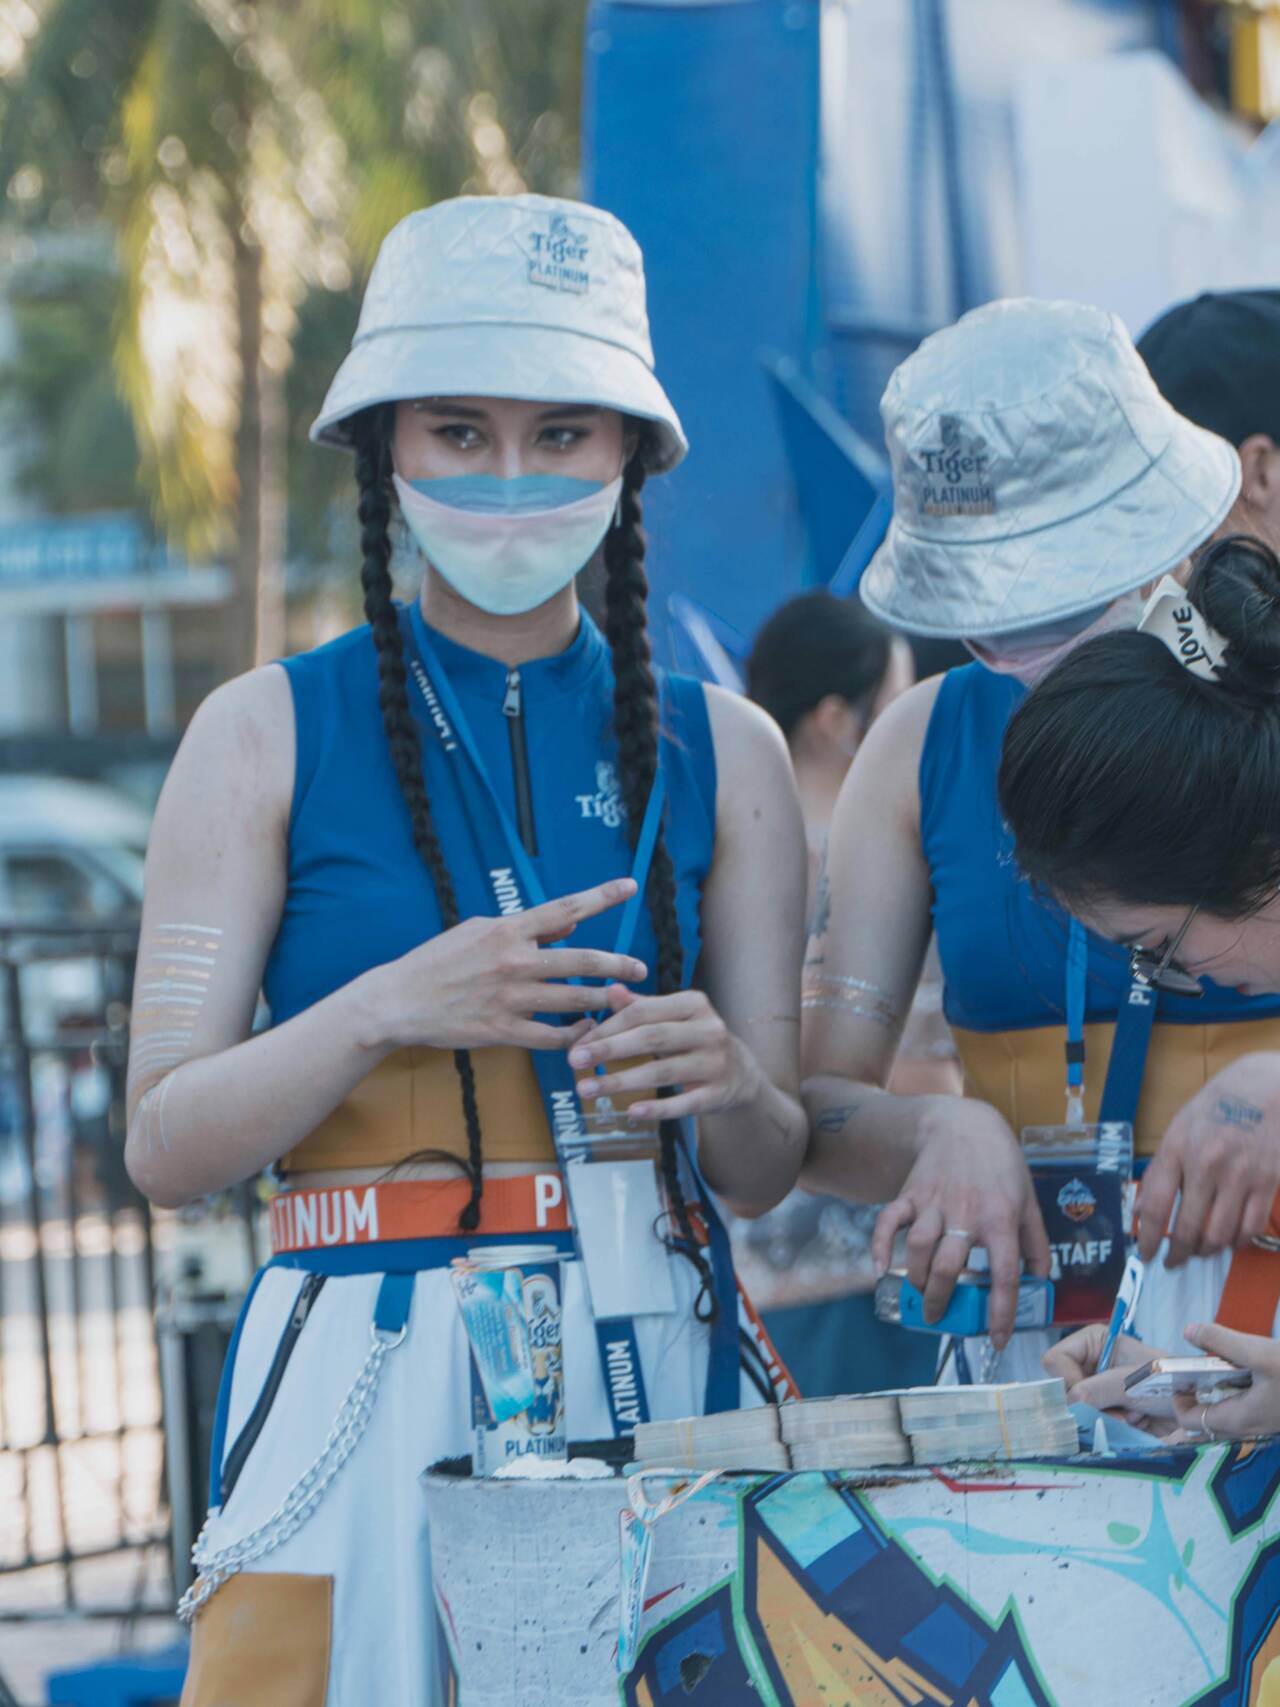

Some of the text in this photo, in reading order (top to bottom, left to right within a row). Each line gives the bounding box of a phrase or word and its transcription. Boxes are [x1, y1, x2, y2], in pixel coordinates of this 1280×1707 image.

[920, 448, 989, 484] Tiger
[923, 486, 991, 503] PLATINUM
[534, 1174, 573, 1227] P
[1049, 1240, 1112, 1266] TAFF
